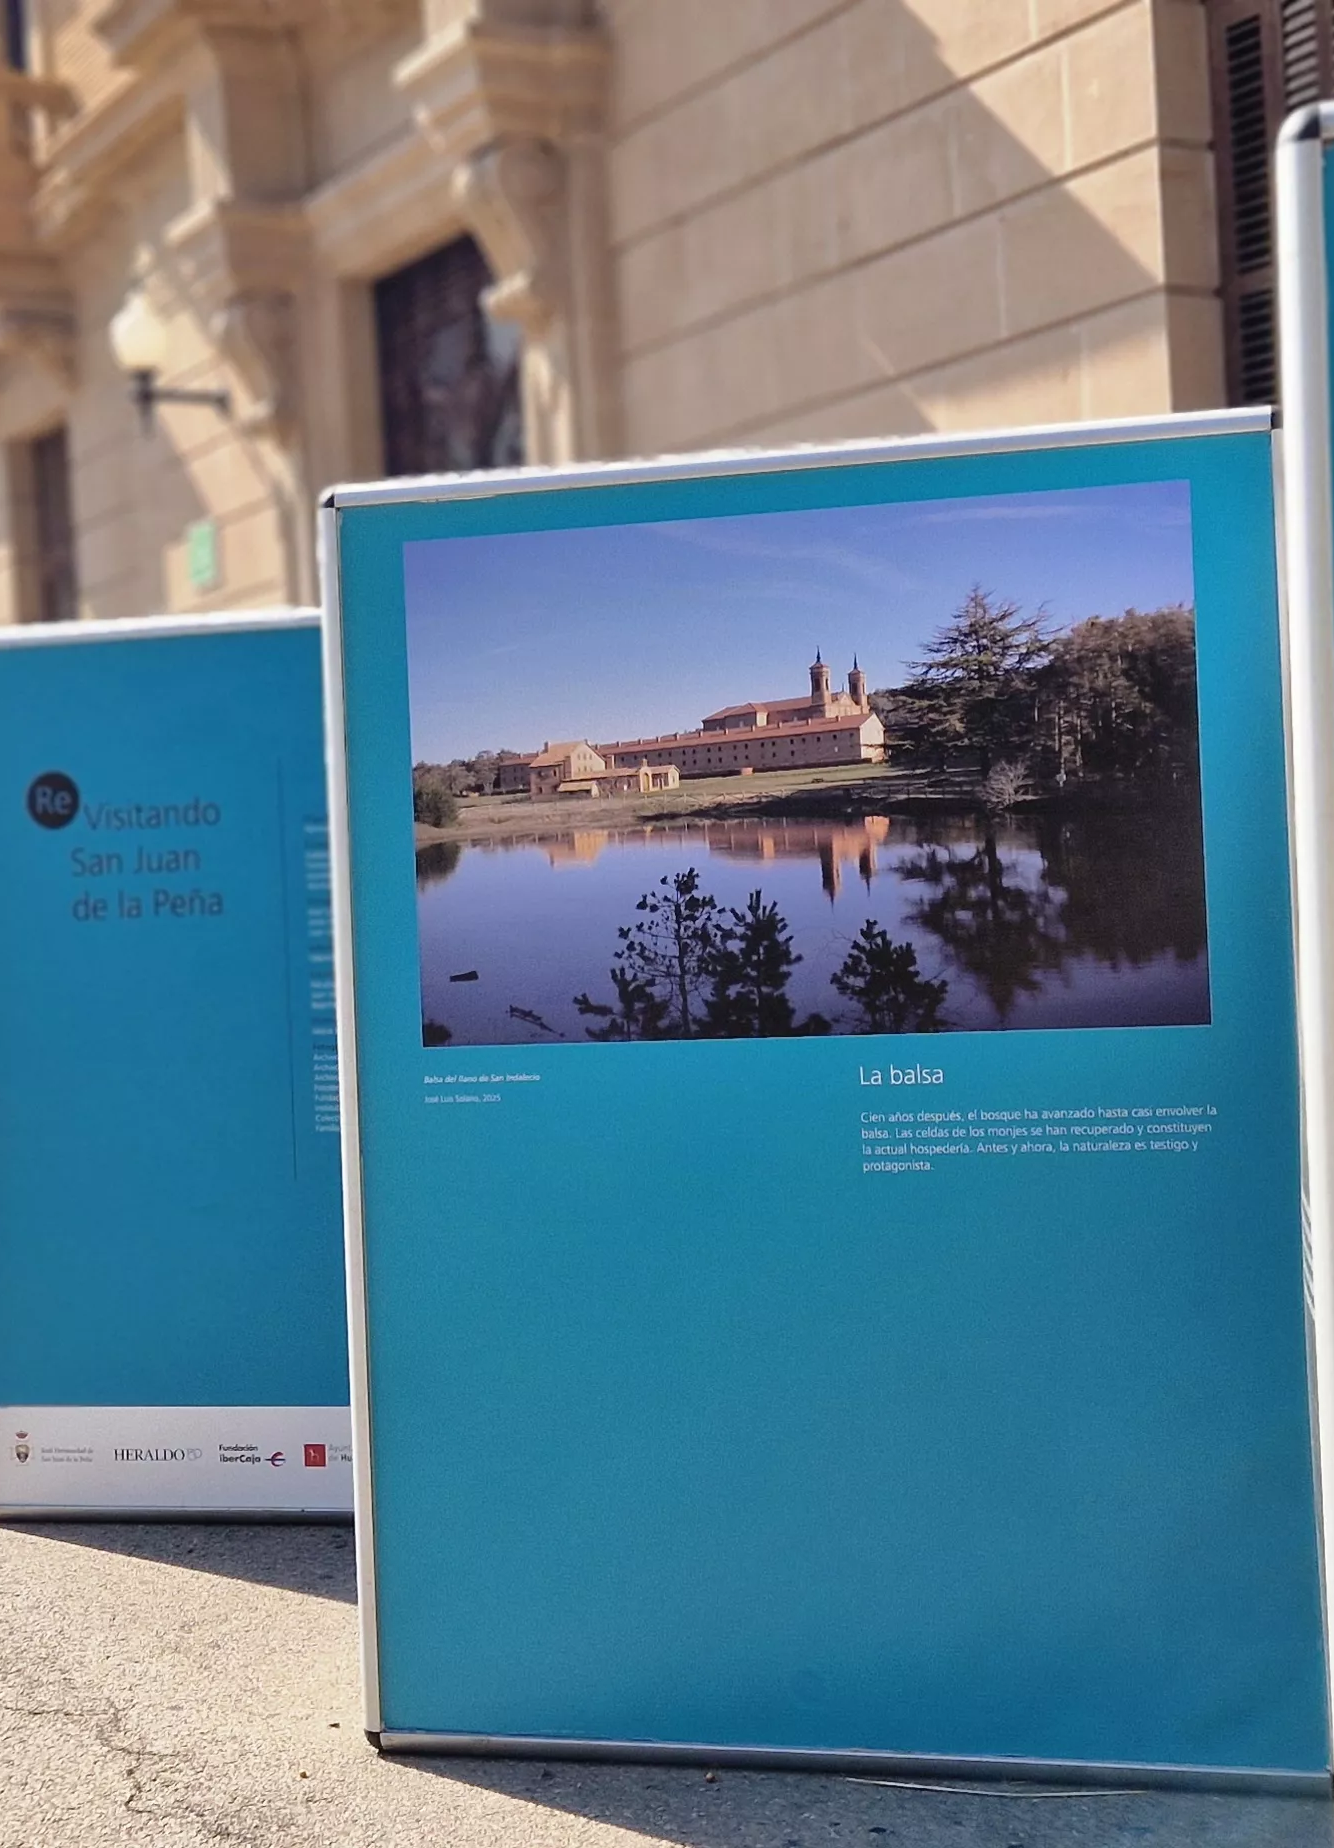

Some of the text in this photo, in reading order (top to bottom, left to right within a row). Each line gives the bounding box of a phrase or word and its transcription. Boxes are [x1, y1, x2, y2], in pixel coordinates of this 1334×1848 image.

[35, 785, 221, 830] Re Visitando
[70, 845, 201, 877] San Juan
[72, 888, 223, 922] de la Peña
[424, 1075, 443, 1084] Balsa
[444, 1075, 457, 1083] del
[479, 1074, 489, 1082] de
[490, 1073, 504, 1082] San
[859, 1063, 944, 1085] La balsa
[483, 1094, 501, 1102] 2025
[861, 1104, 1217, 1123] Cien años después, el bosque ha avanzado hasta casi envolver la
[861, 1122, 1212, 1139] balsa. Las celdas de los monjes se han recuperado y constituyen
[862, 1139, 1198, 1157] la actual hospedería. Antes y ahora, la naturaleza es testigo y
[863, 1159, 934, 1174] protagonista.
[114, 1448, 185, 1461] HERALDO
[219, 1443, 258, 1452] Fundación
